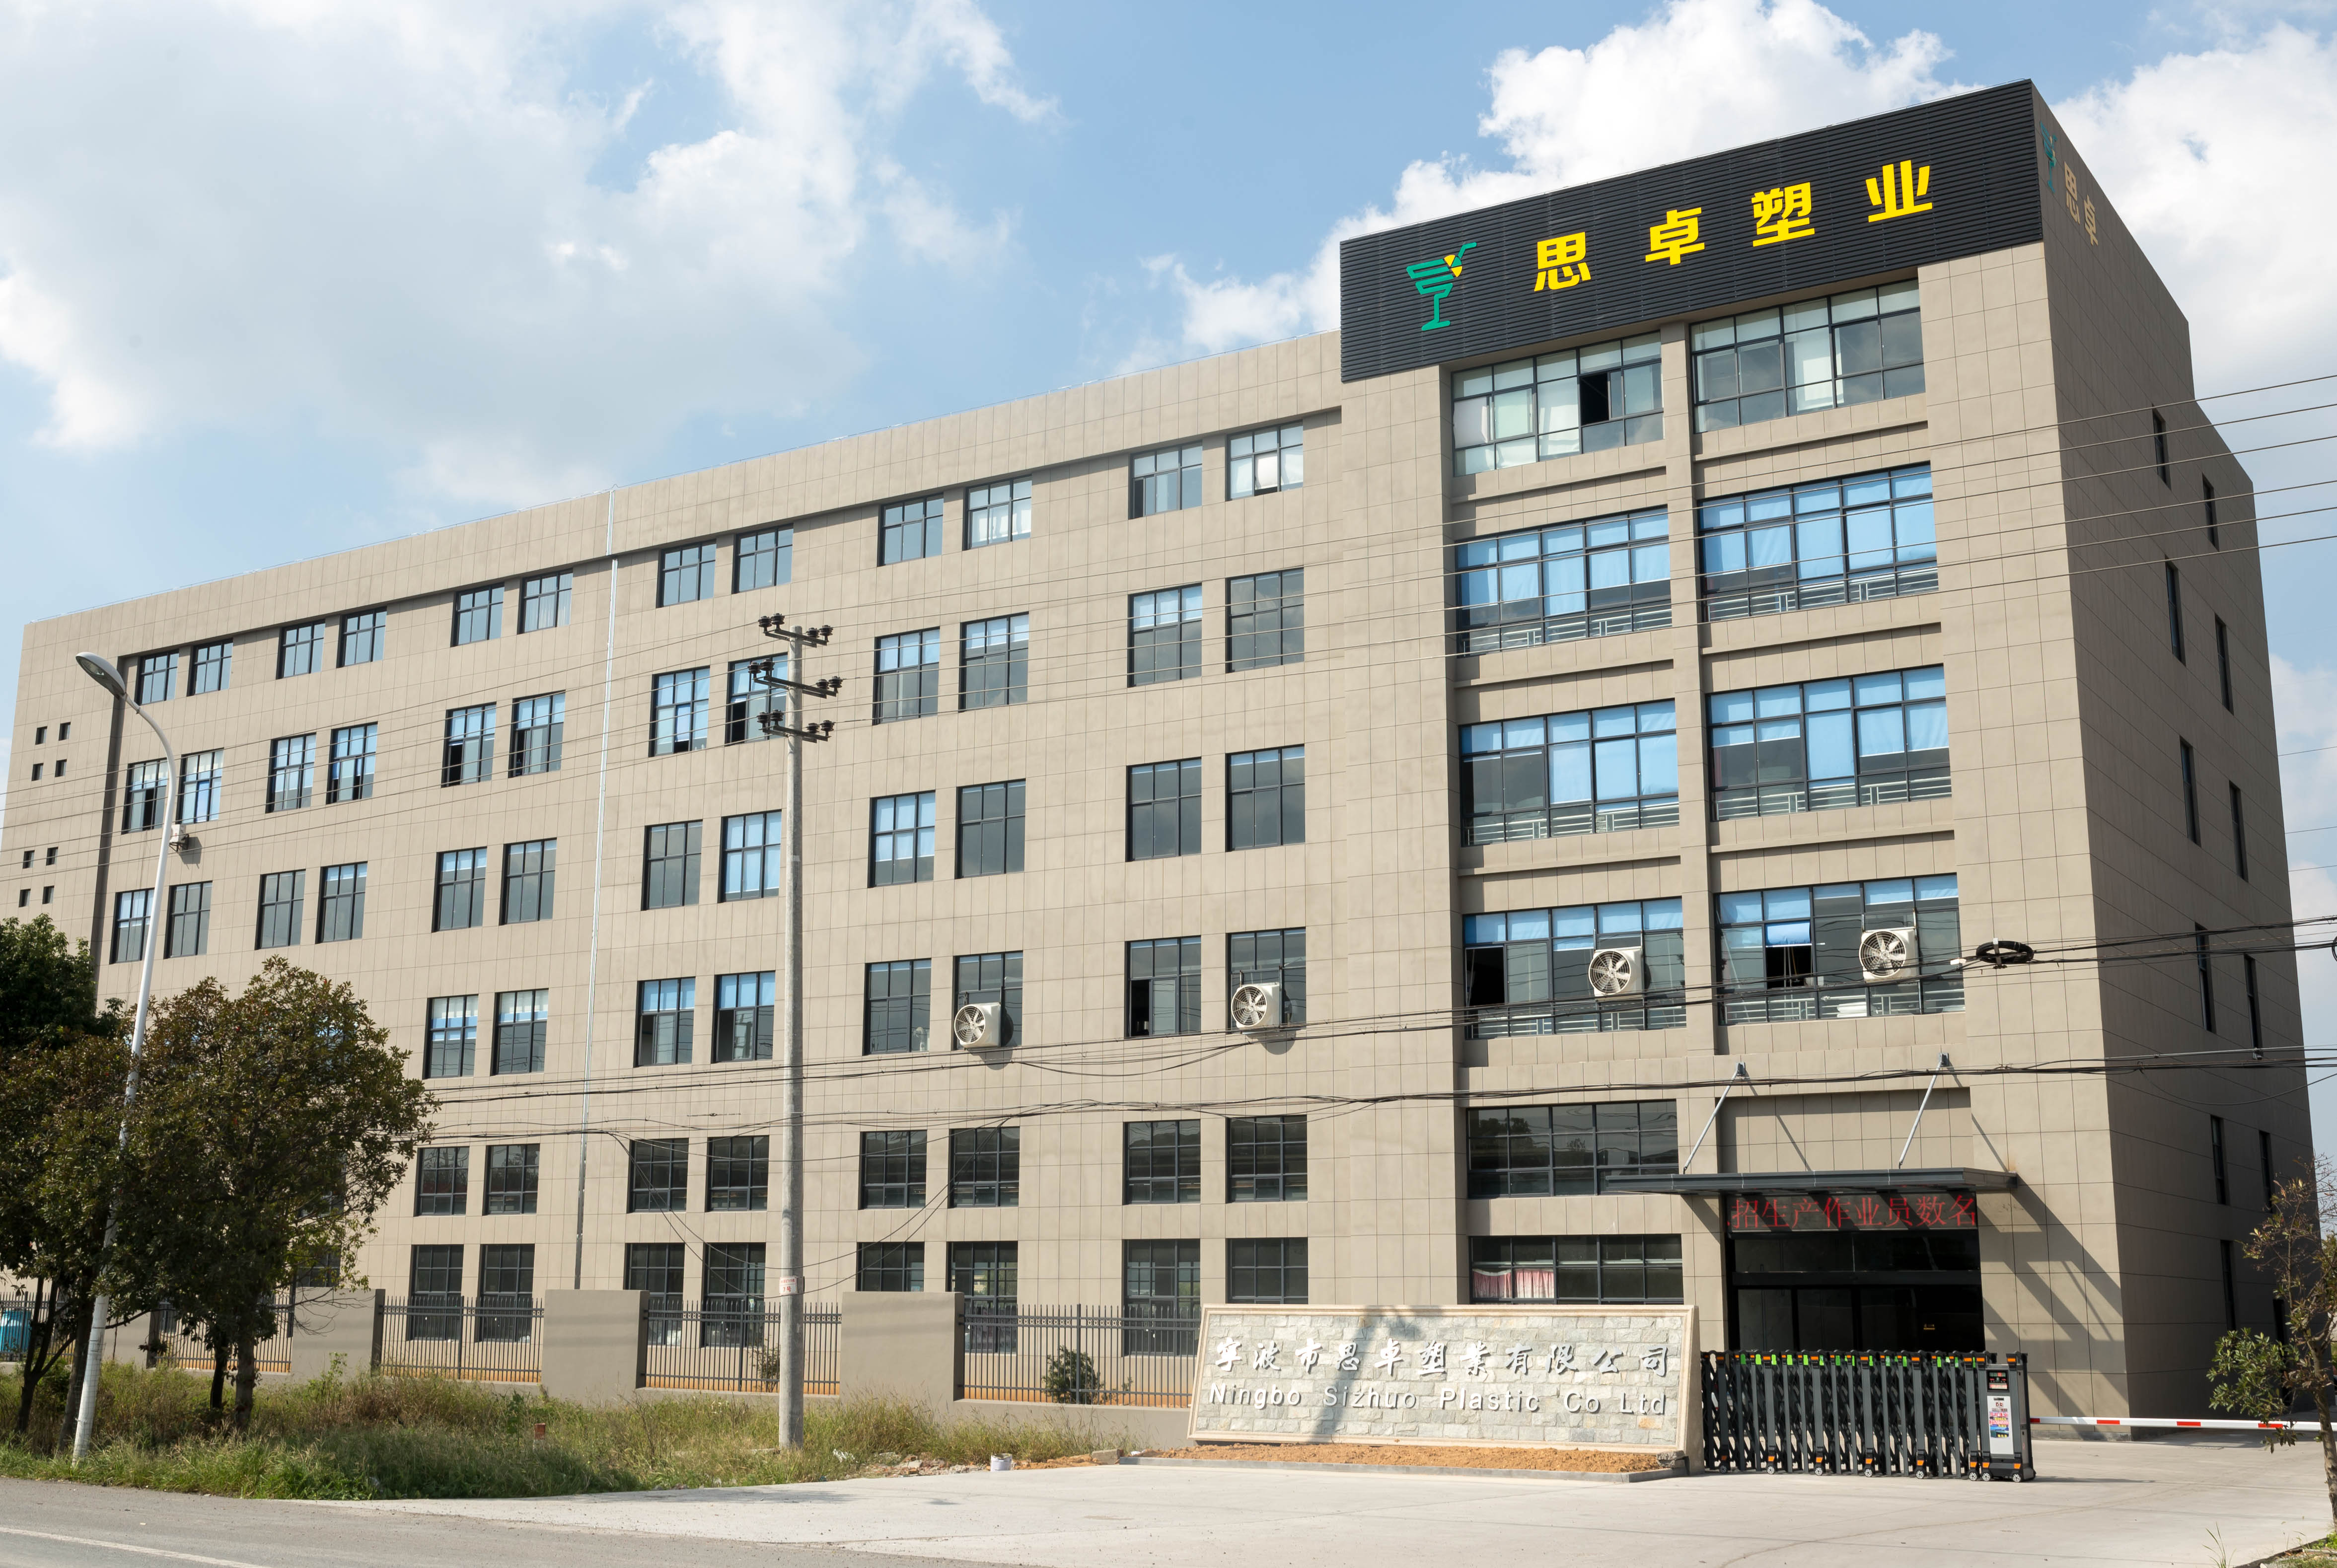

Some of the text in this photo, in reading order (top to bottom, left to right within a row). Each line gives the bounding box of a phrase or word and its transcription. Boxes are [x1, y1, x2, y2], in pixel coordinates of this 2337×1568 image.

[1534, 159, 1933, 291] 思卓塑业
[2064, 159, 2098, 246] 思卓
[1731, 1194, 1975, 1228] 招生产作业员数名
[1209, 1381, 1667, 1415] Ningbo Sizhuo Plastic Co Ltd
